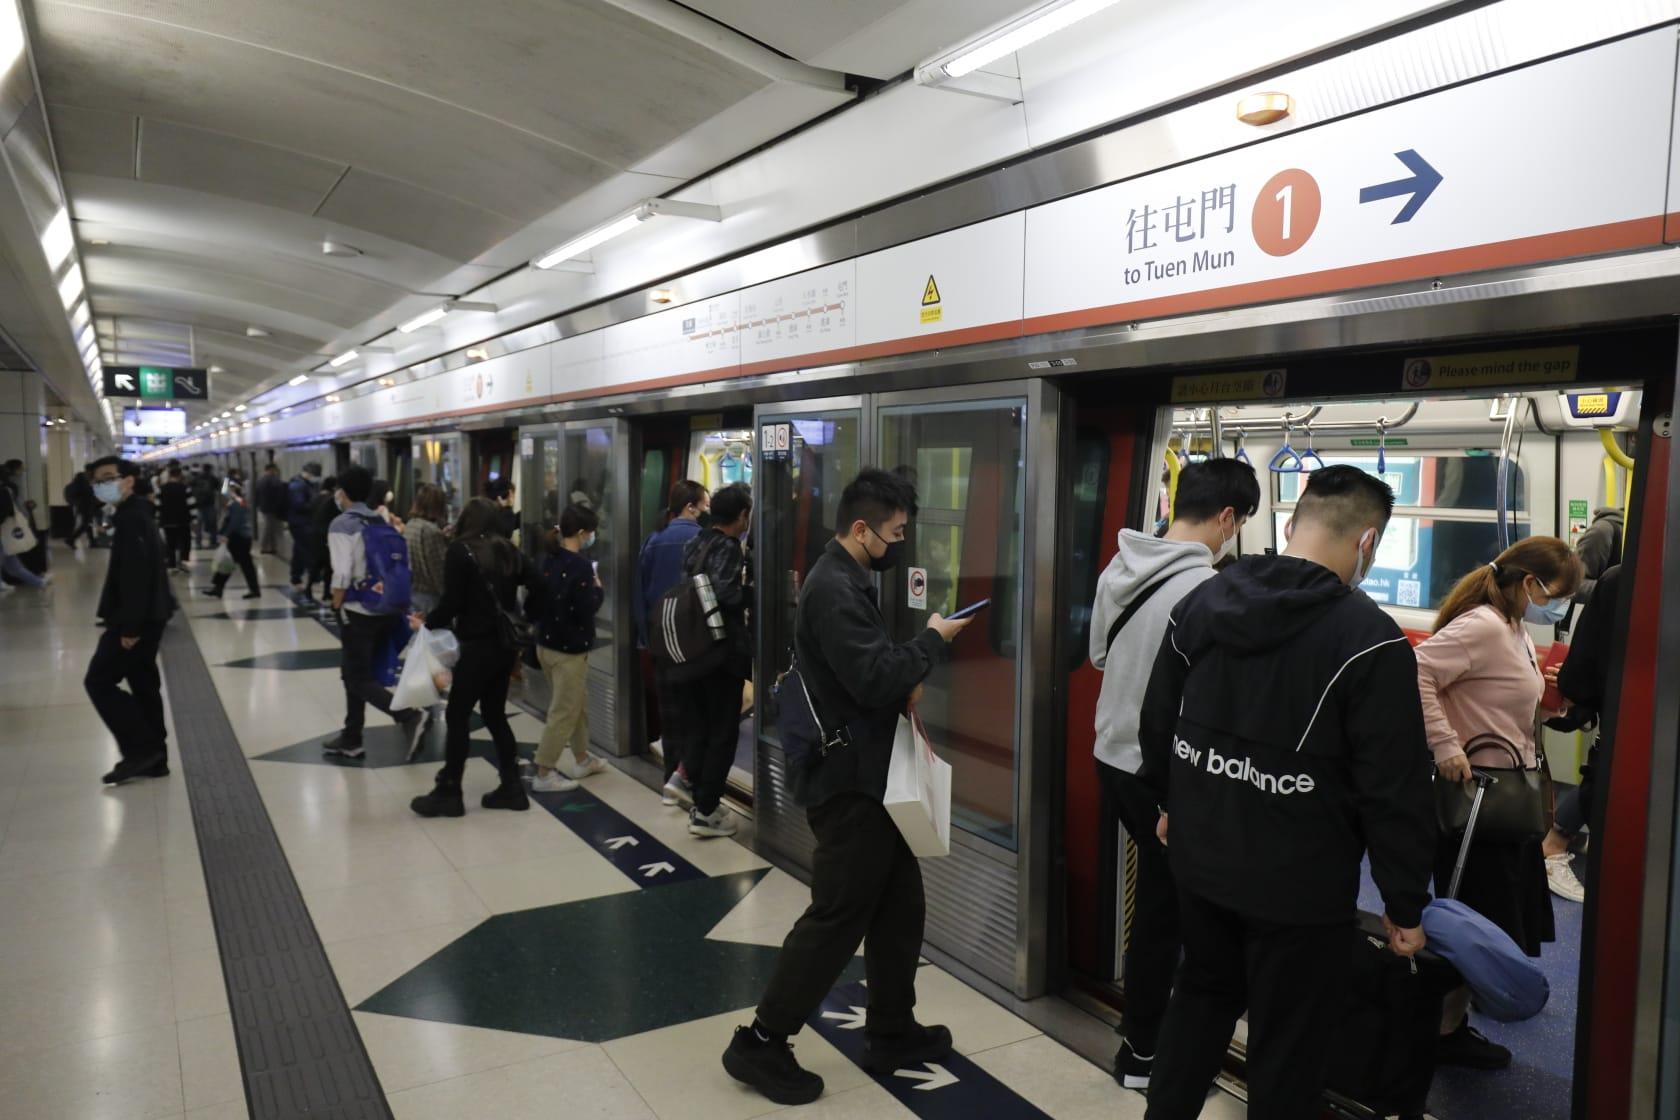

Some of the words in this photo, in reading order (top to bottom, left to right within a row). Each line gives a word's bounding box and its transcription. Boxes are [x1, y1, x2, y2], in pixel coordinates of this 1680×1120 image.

[1125, 183, 1238, 255] 往屯門
[1274, 184, 1293, 240] 1
[1124, 267, 1141, 285] to
[1144, 257, 1187, 281] Tuen
[1192, 248, 1236, 273] Mun
[1439, 365, 1479, 377] Please
[1479, 361, 1515, 374] mind
[1519, 360, 1542, 372] the
[1544, 360, 1571, 374] gap
[1173, 734, 1202, 767] new
[1207, 748, 1315, 795] balance
